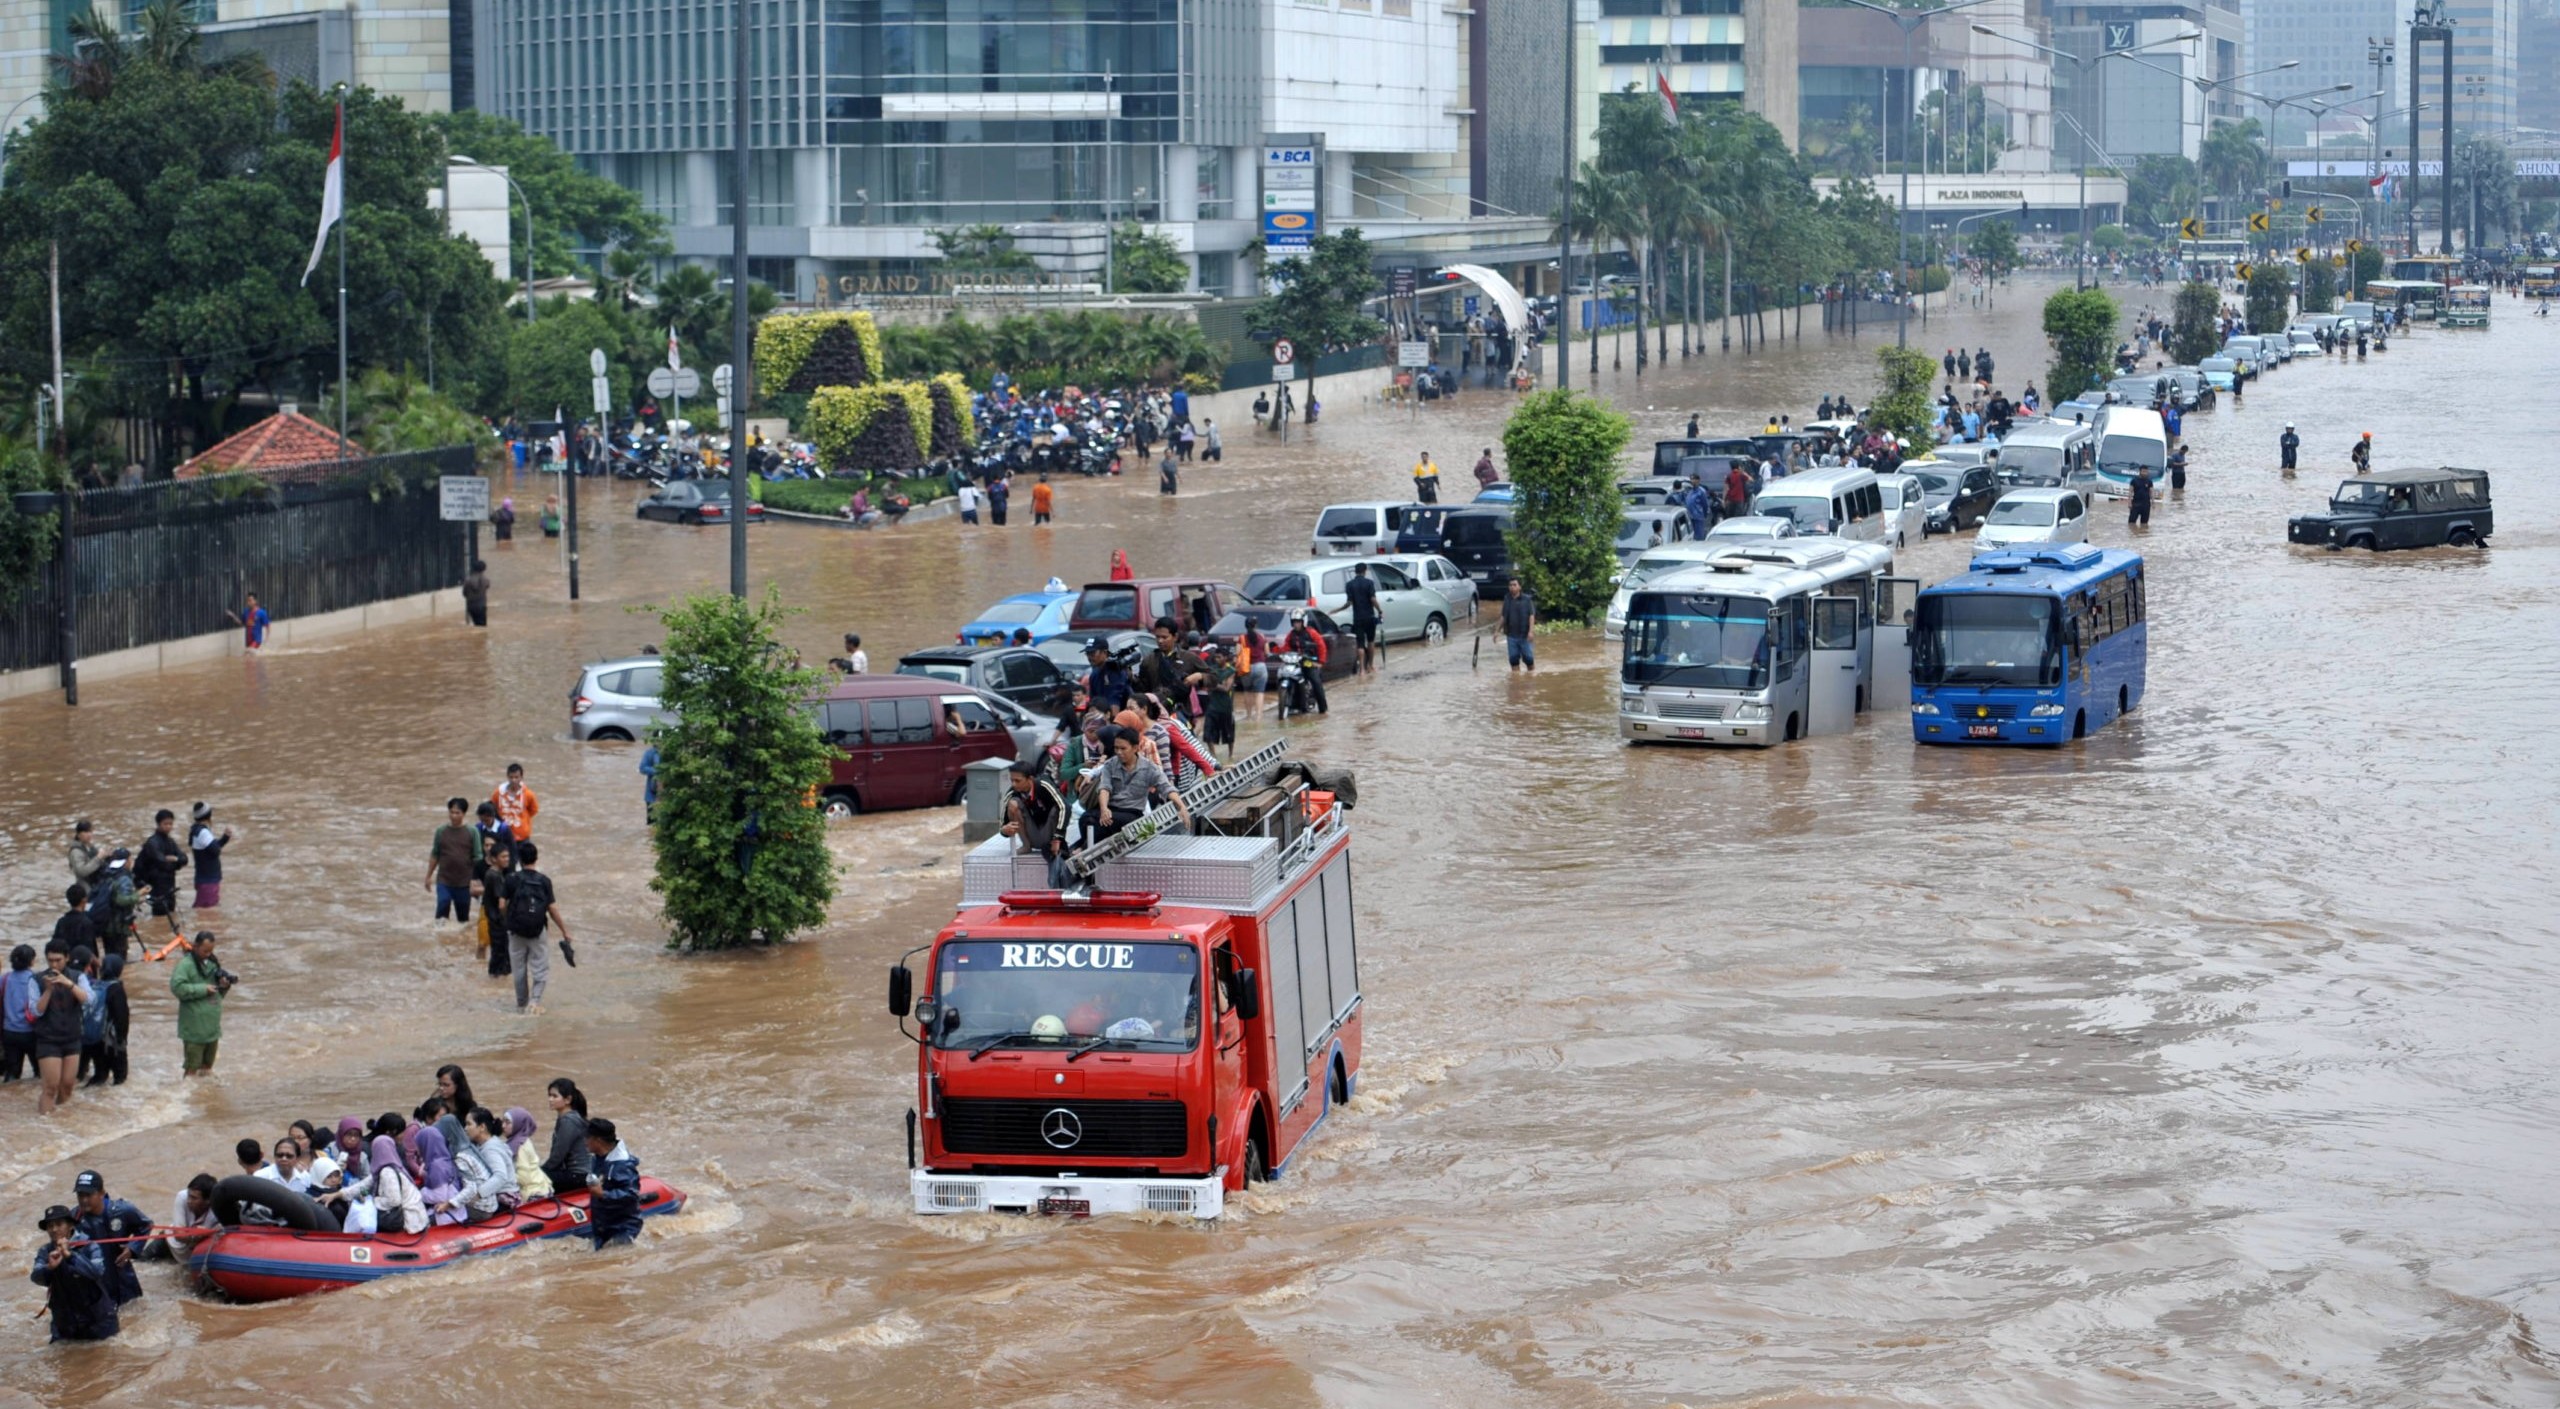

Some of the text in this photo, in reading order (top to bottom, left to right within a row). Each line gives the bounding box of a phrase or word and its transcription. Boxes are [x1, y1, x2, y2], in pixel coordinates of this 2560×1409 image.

[1284, 151, 1311, 162] BCA
[1938, 190, 2025, 200] PLAZA INDONESIA
[839, 271, 1074, 293] GRAND INDONESIA
[1001, 944, 1134, 969] RESCUE
